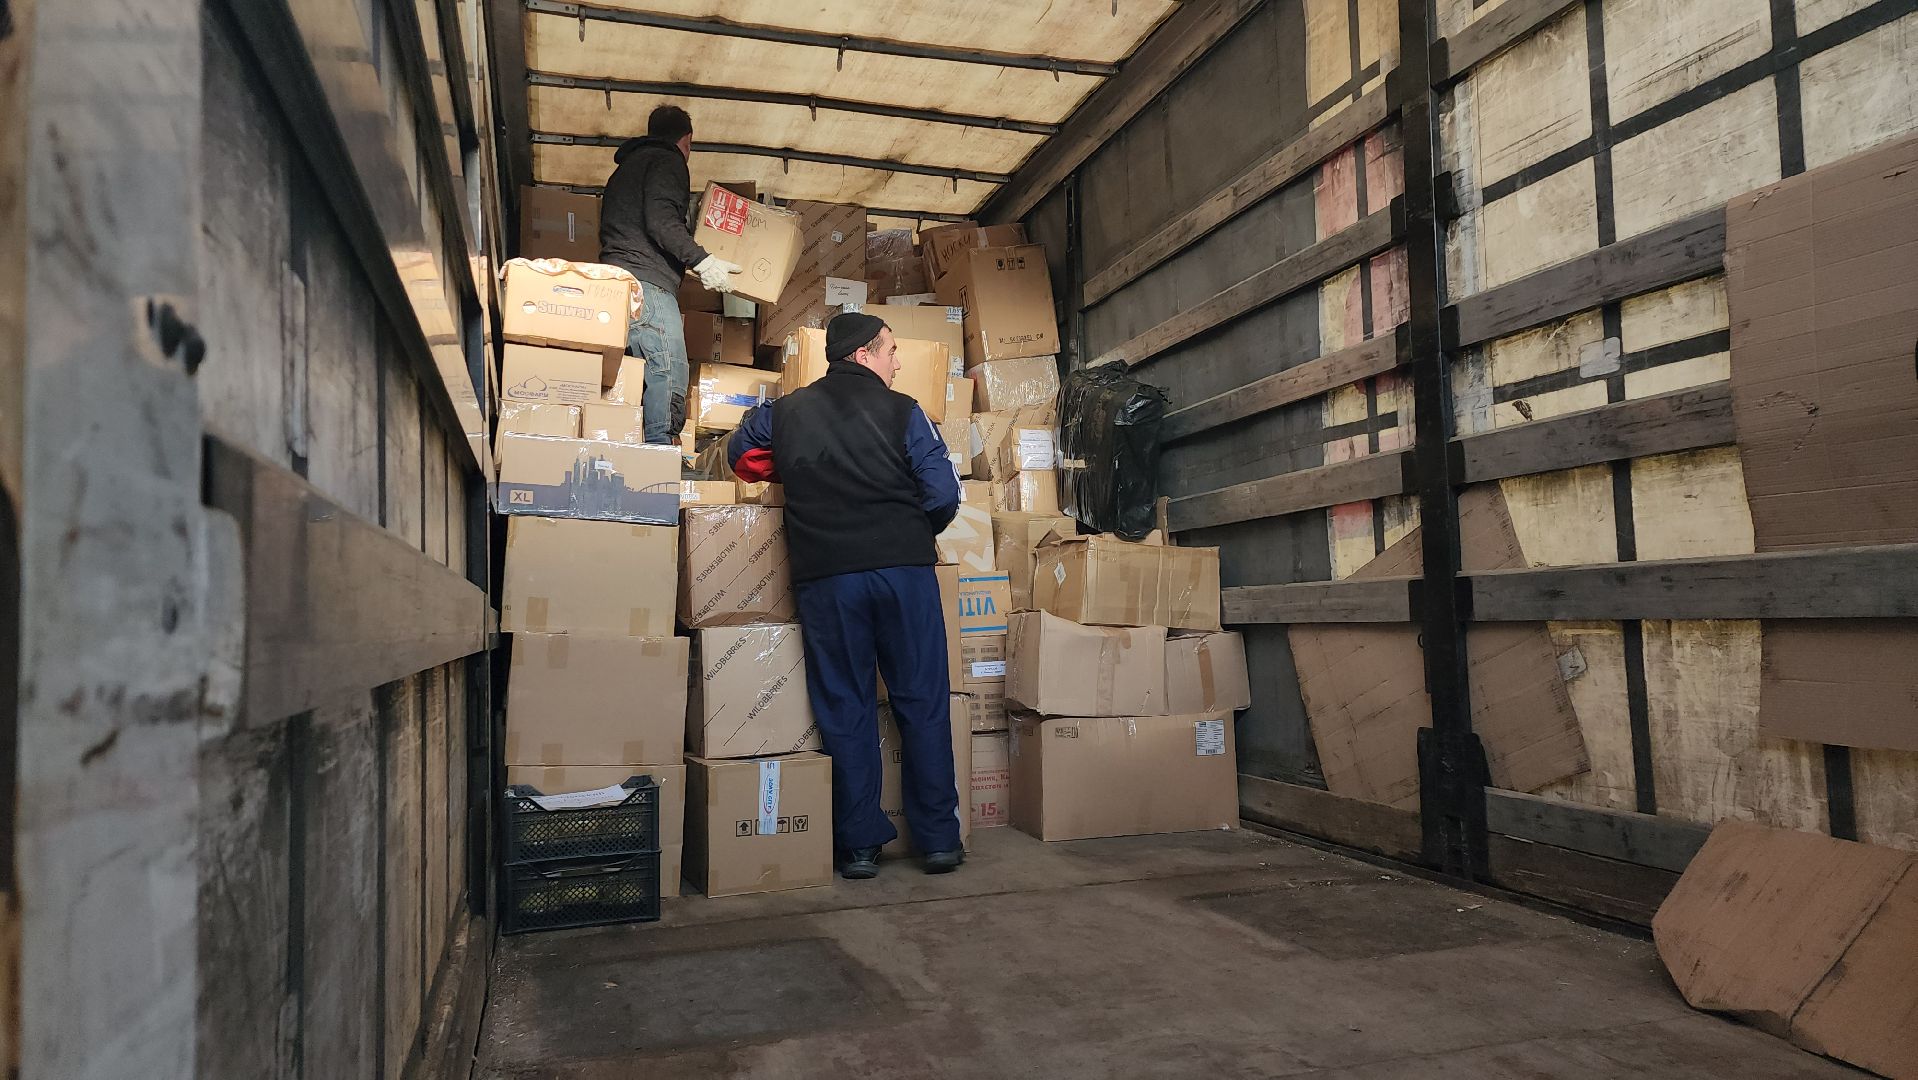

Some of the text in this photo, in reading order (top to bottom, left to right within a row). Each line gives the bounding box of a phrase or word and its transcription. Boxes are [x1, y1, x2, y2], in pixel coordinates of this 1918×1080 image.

[941, 231, 972, 263] НОСКИ
[537, 299, 595, 321] Sunway
[513, 492, 531, 503] XL
[695, 540, 738, 584] WILDBERRIES
[736, 569, 777, 611] WILDBERRIES
[703, 636, 747, 681] WILDBERRIES
[746, 675, 788, 720] WILDBERRIES
[980, 802, 997, 817] 15
